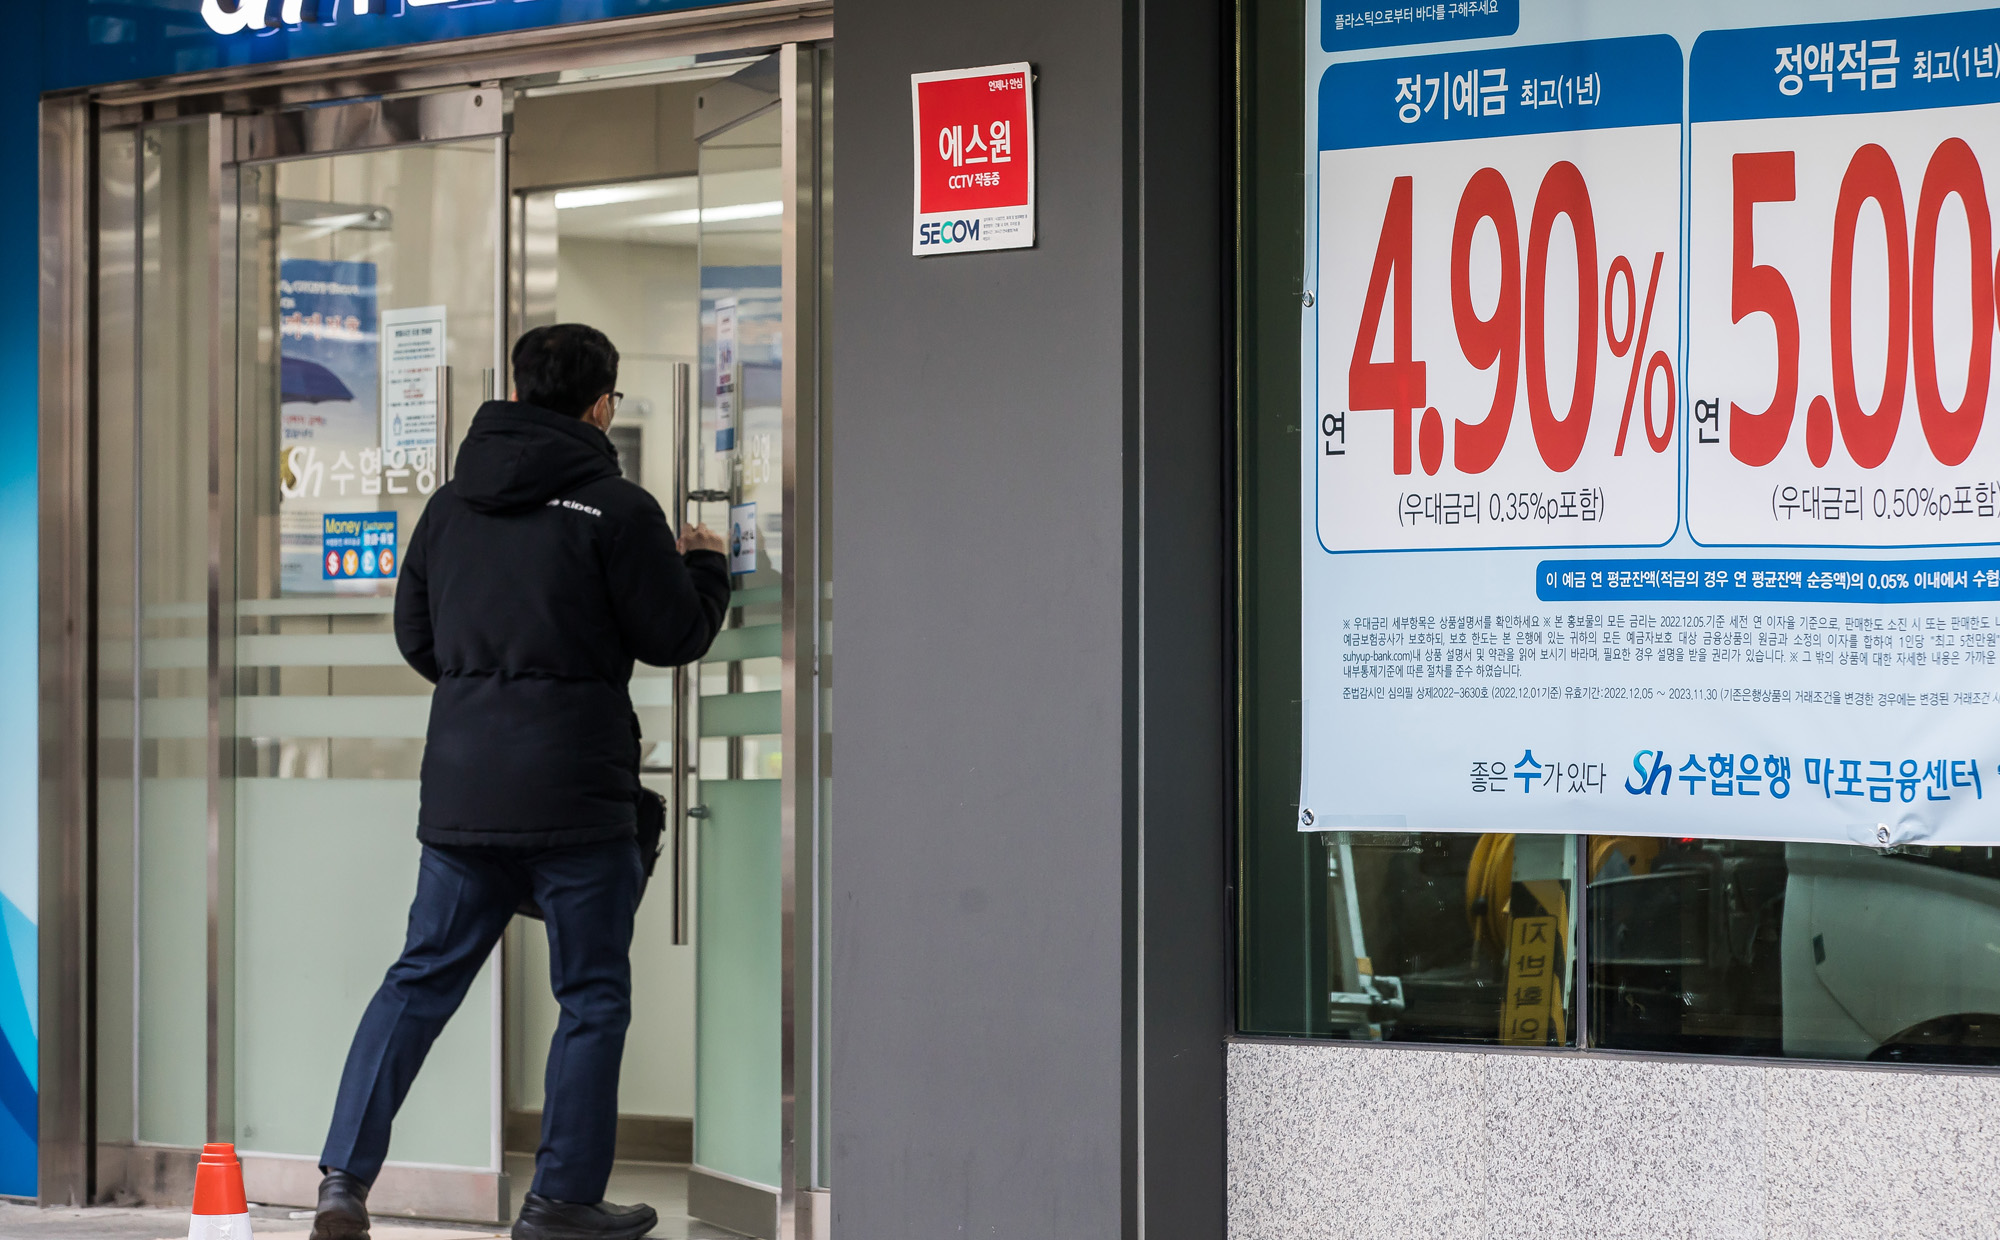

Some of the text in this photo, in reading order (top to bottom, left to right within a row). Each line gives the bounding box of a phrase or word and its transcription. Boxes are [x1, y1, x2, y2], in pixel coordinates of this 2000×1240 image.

[1334, 0, 1499, 31] 플라스틱으로부터 바다를 구해주세요
[1774, 39, 1900, 96] 정액적금
[988, 77, 1023, 92] 언제나 안심
[1395, 68, 1601, 123] 정기예금 최고(1년)
[938, 120, 1012, 167] 에스원
[948, 171, 1000, 190] CCTV 작동중
[919, 218, 980, 246] SECOM
[1694, 138, 2000, 470] 연 5.00
[1322, 411, 1346, 456] 연
[280, 446, 436, 499] Sh 수협은행
[1398, 485, 1605, 526] (우대금리 0.35%p포함)
[1771, 484, 1863, 522] (우대금리
[325, 517, 361, 537] Money
[1546, 569, 2000, 590] 이 예금 연 평균잔액(적금의 경우 연 평균잔액 순증액)의 0.05% 이내에서 수협
[1353, 616, 1388, 630] 우대금리
[1392, 616, 1436, 630] 세부항목은
[1439, 615, 1492, 630] 상품설명서를
[1495, 615, 1540, 629] 확인하세요
[1554, 615, 1564, 628] 본
[1566, 614, 1603, 629] 홍보물의
[1606, 614, 1626, 627] 모든
[1629, 614, 1657, 628] 금리는
[1729, 614, 1748, 628] 세전
[1752, 615, 1762, 629] 연
[1766, 615, 1796, 630] 이자율
[1799, 615, 1841, 632] 기준으로,
[1844, 616, 1885, 632] 판매한도
[1887, 616, 1907, 632] 소진
[1911, 616, 1921, 632] 시
[1925, 616, 1947, 631] 또는
[1950, 615, 1991, 631] 판매한도
[1343, 632, 1405, 647] 예금보험공사가
[1408, 631, 1446, 646] 보호하되,
[1449, 632, 1468, 645] 보호
[1471, 631, 1498, 645] 한도는
[1502, 631, 1512, 645] 본
[1515, 631, 1543, 645] 은행에
[1547, 631, 1566, 645] 있는
[1568, 631, 1598, 646] 귀하의
[1601, 631, 1621, 644] 모든
[1625, 631, 1674, 645] 예금자보호
[1678, 631, 1698, 646] 대상
[1702, 631, 1753, 646] 금융상품의
[1757, 632, 1789, 647] 원금과
[1793, 632, 1822, 648] 소정의
[1827, 633, 1859, 649] 이자를
[1863, 633, 1893, 650] 합하여
[1898, 633, 1925, 649] 1인당
[1342, 647, 1422, 663] suhyup-bank.com)내
[1424, 647, 1443, 662] 상품
[1445, 647, 1473, 662] 설명서
[1475, 647, 1485, 662] 및
[1487, 647, 1515, 662] 약관을
[1518, 647, 1537, 662] 읽어
[1539, 647, 1568, 662] 보시기
[1570, 647, 1600, 663] 바라며,
[1603, 647, 1631, 662] 필요한
[1634, 647, 1654, 662] 경우
[1657, 647, 1685, 662] 설명을
[1688, 647, 1708, 662] 받을
[1711, 647, 1742, 663] 권리가
[1745, 648, 1787, 664] 있습니다.
[1801, 650, 1813, 663] 그
[1815, 650, 1835, 665] 밖의
[1838, 650, 1869, 666] 상품에
[1872, 651, 1893, 667] 대한
[1896, 651, 1927, 667] 자세한
[1931, 650, 1961, 666] 내용은
[1964, 649, 1997, 665] 가까운
[1343, 663, 1523, 679] 내부통제기준에 따른 절차를 준수 하였습니다.
[1342, 686, 1386, 700] 준법감시인
[1387, 686, 1414, 700] 심의필
[1668, 686, 1718, 701] 2023.11.30
[1794, 689, 1842, 705] 거래조건을
[1844, 691, 1875, 707] 변경한
[1877, 691, 1918, 708] 경우에는
[1919, 691, 1950, 707] 변경된
[1953, 691, 1991, 706] 거래조건
[1470, 761, 1508, 791] 좋은
[1624, 749, 1983, 803] Sh 수협은행 마포금융센터
